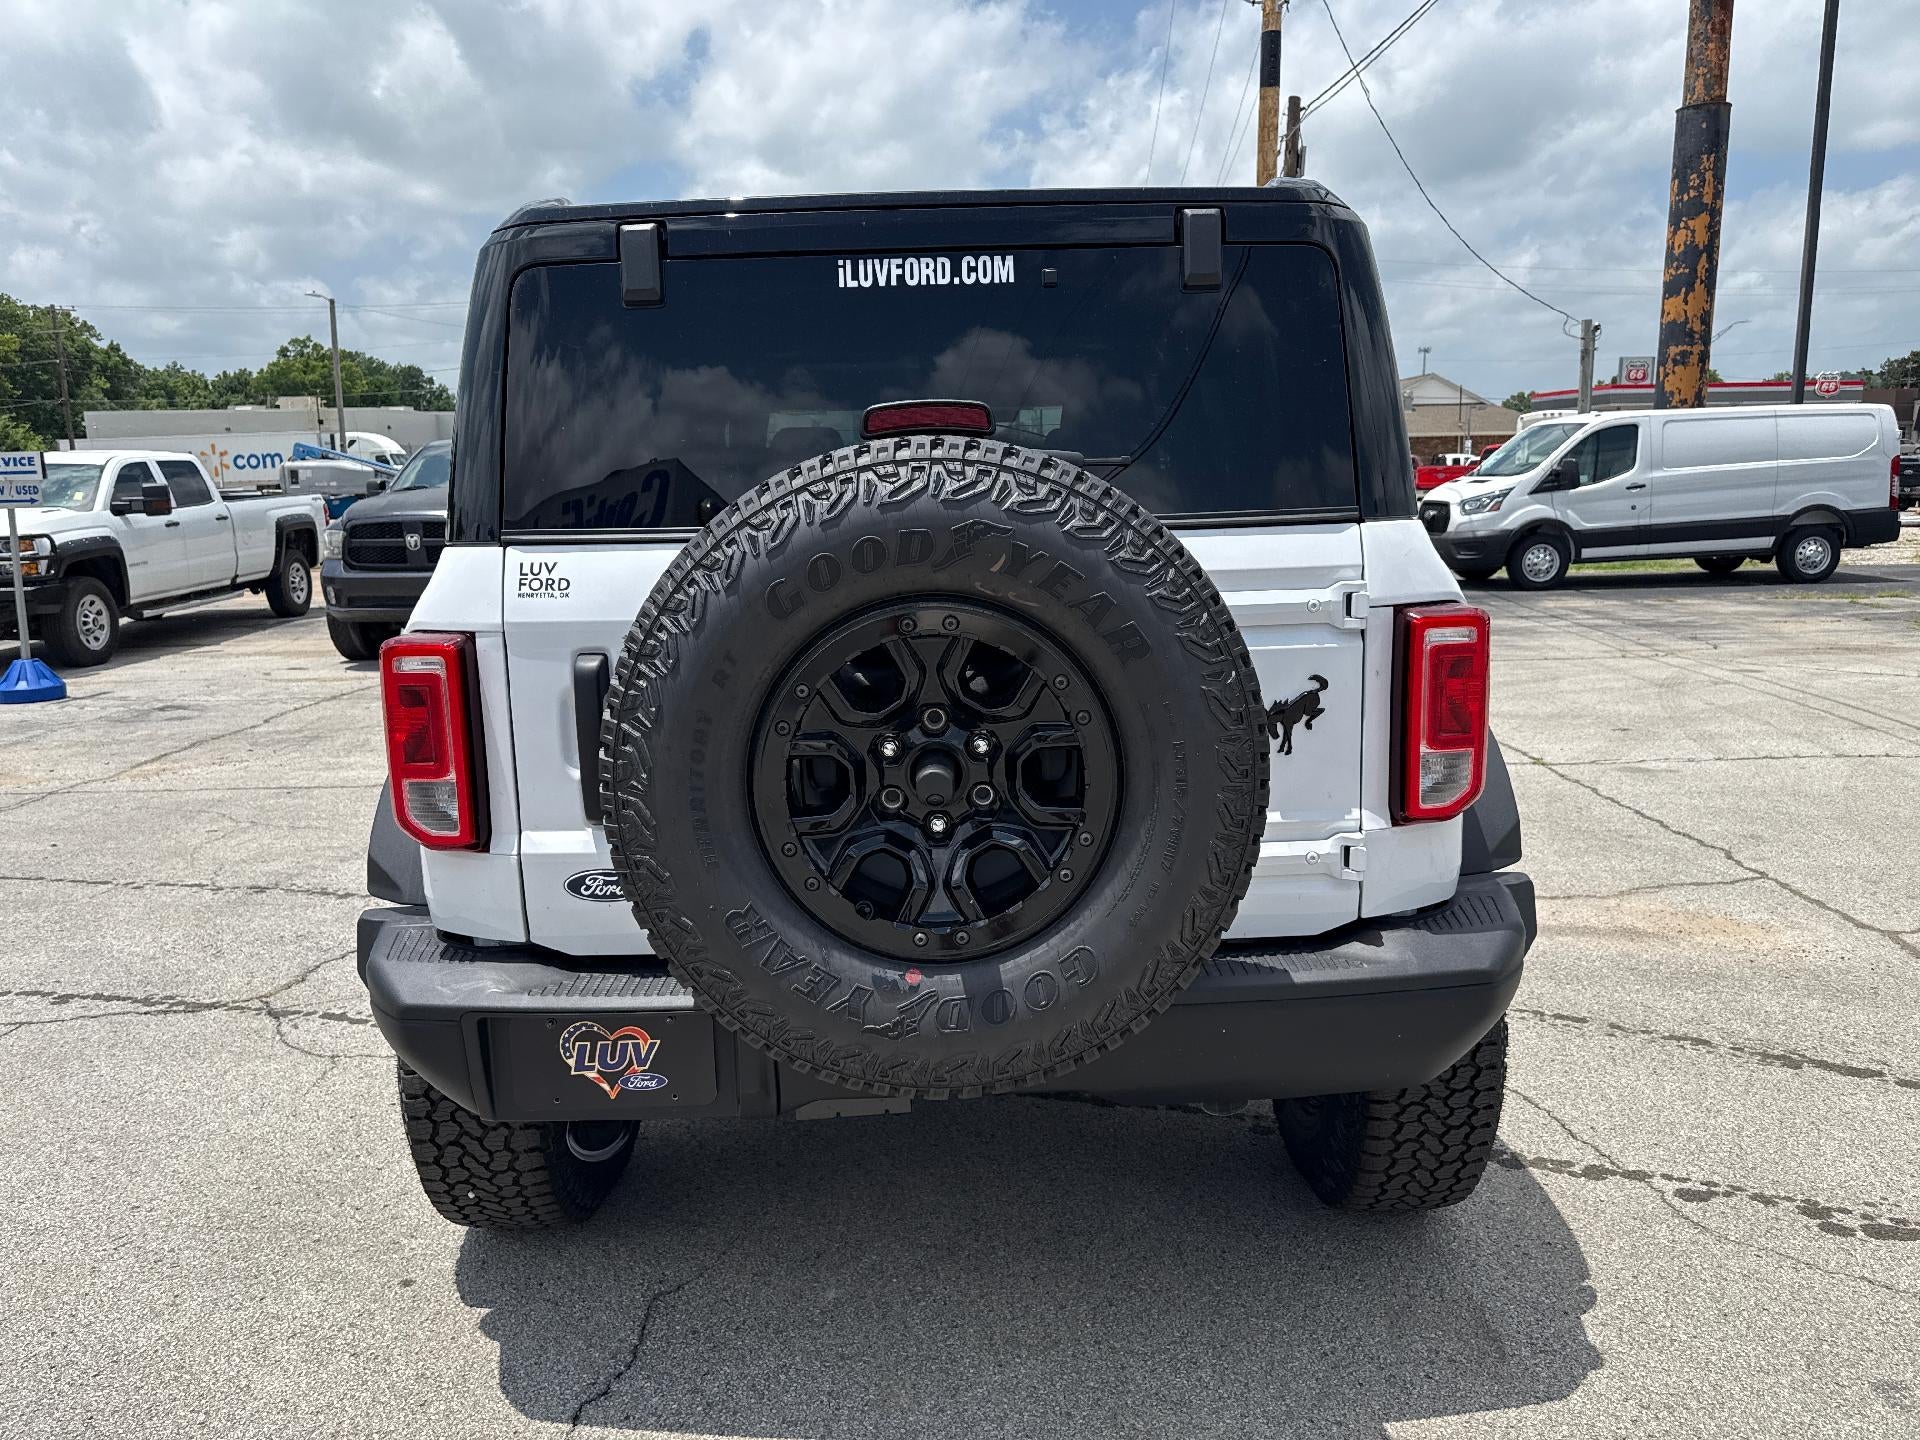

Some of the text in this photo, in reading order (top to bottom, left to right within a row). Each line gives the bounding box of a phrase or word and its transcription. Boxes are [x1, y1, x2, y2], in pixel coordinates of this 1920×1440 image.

[838, 255, 1014, 288] iLUVFORD.COM
[1629, 370, 1645, 380] 66
[1821, 382, 1837, 391] 66
[0, 456, 35, 466] VICE
[233, 452, 283, 470] com
[15, 485, 39, 495] USED
[519, 561, 558, 576] LUV
[518, 577, 571, 592] FORD
[571, 1039, 661, 1075] LUV
[627, 1075, 658, 1088] Ford
